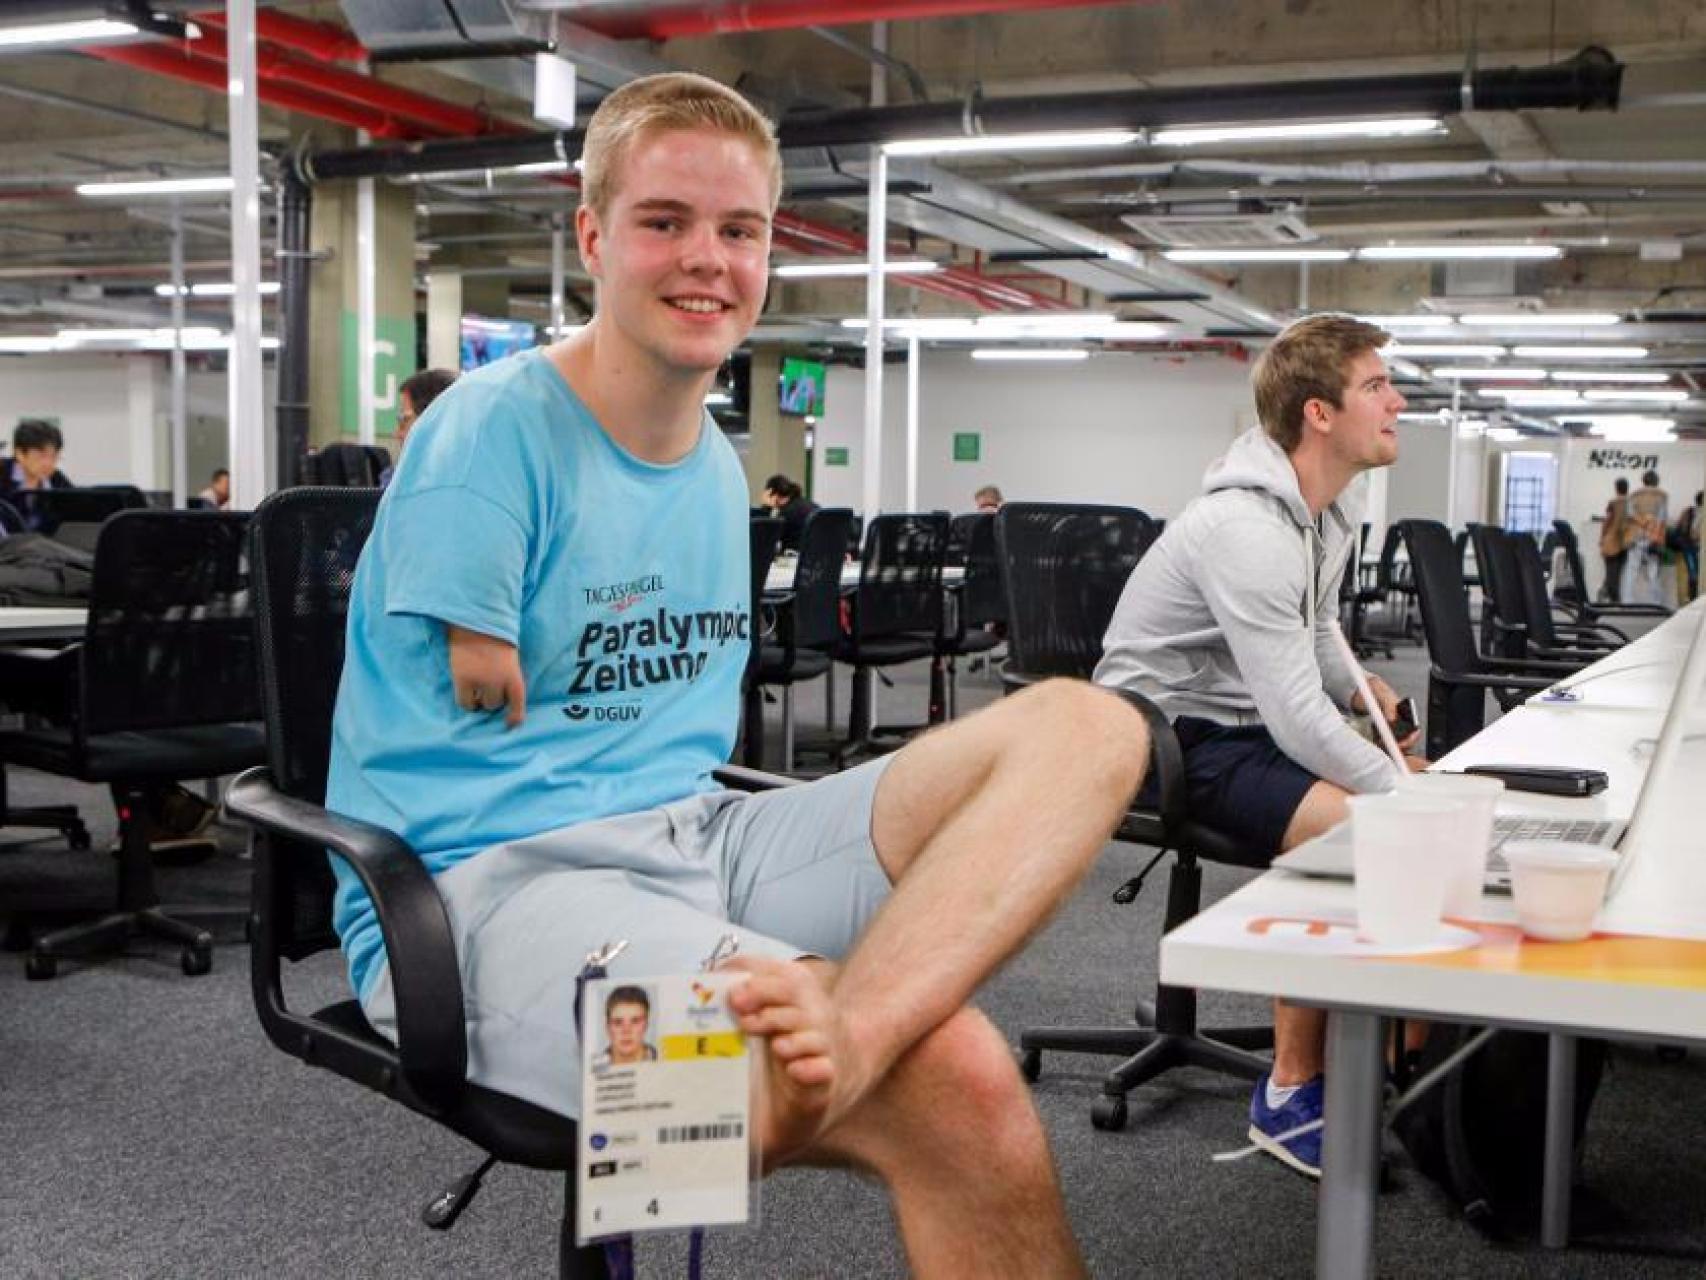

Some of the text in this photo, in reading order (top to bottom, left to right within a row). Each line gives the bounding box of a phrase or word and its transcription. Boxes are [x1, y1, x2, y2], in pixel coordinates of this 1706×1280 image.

[584, 575, 664, 605] TAGESGEL
[577, 603, 748, 657] Paralympic
[594, 706, 642, 721] DGUV
[646, 1198, 659, 1215] 4
